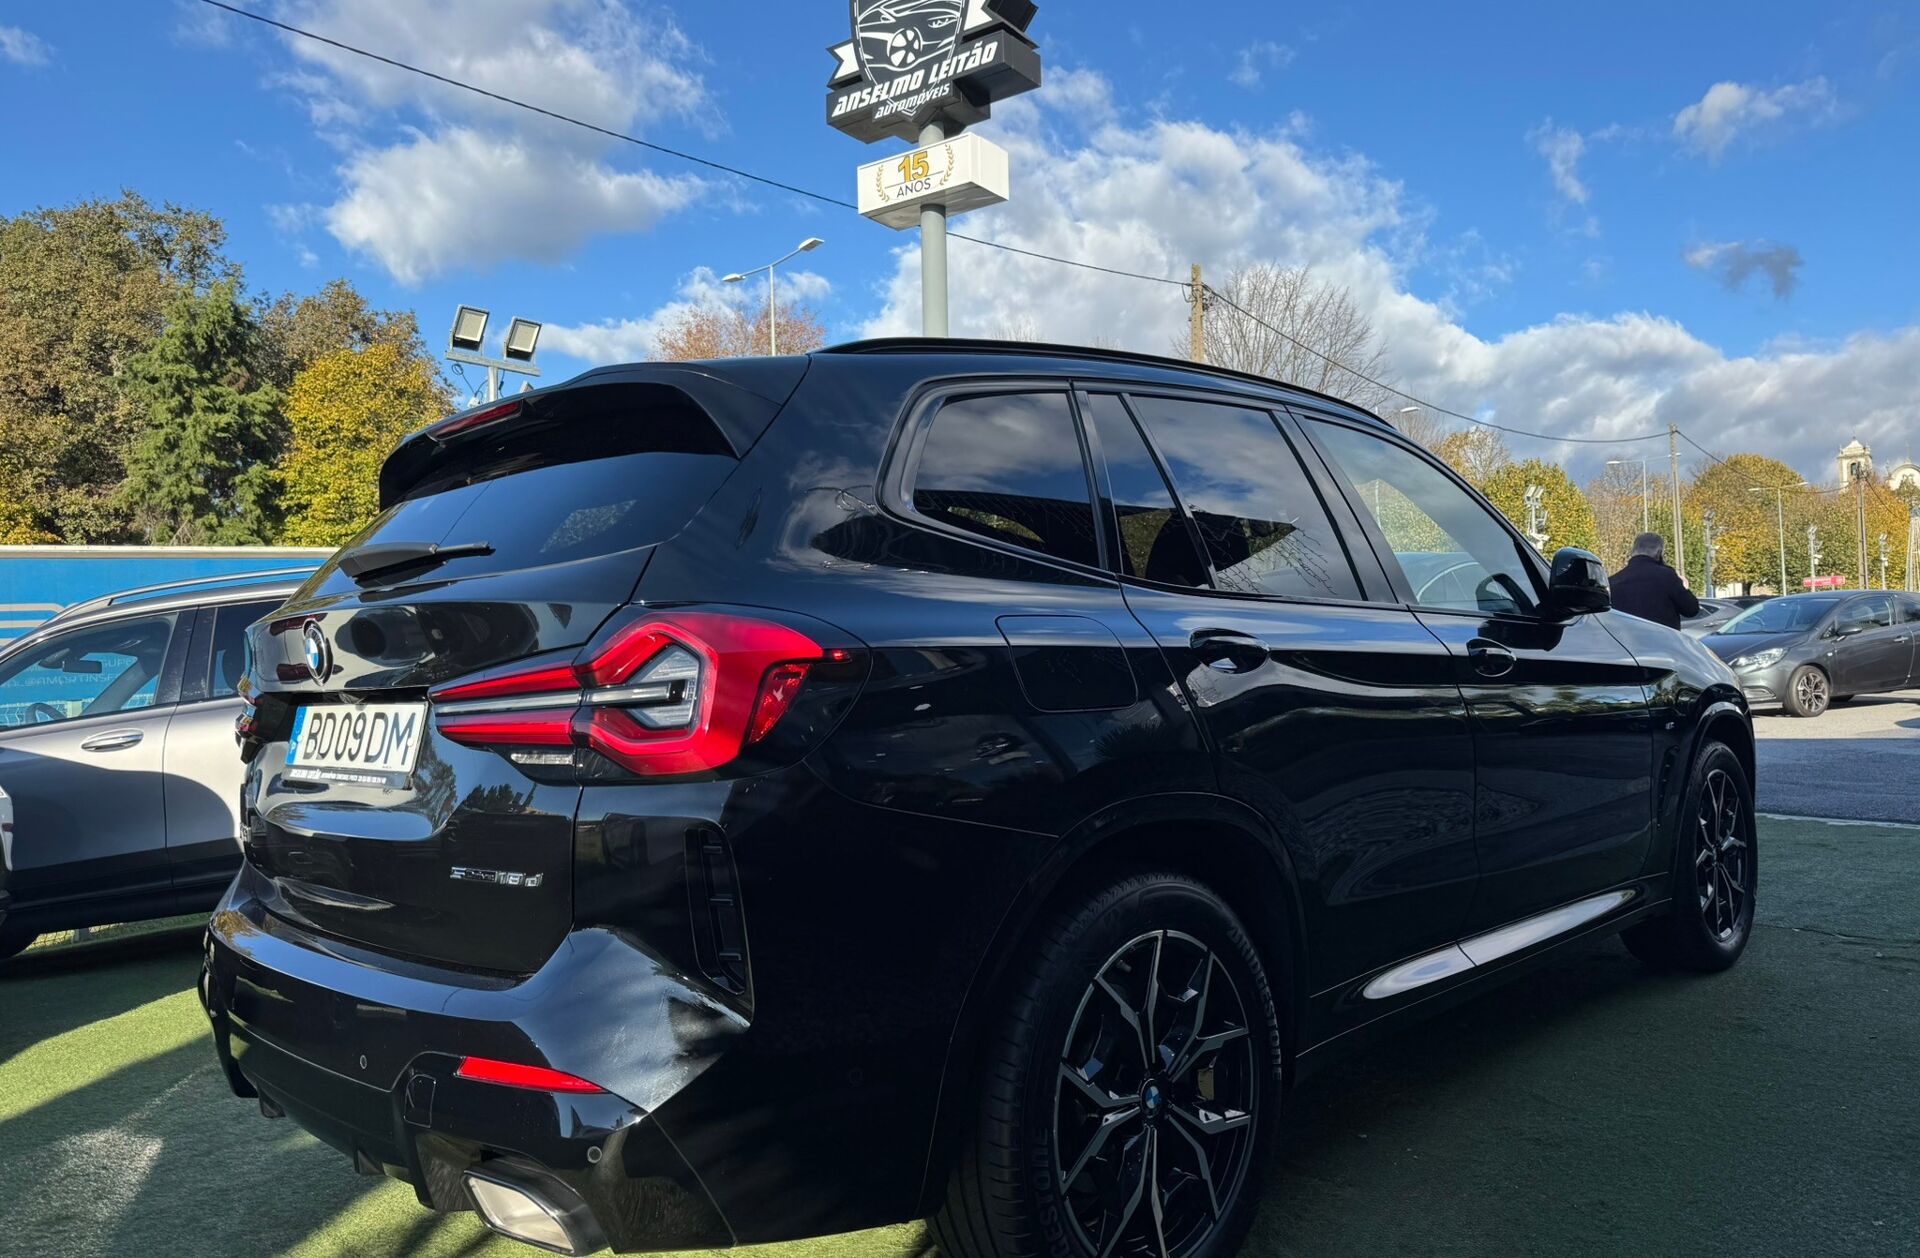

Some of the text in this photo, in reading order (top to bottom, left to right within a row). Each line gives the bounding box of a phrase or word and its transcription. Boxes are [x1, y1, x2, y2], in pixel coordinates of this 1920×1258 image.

[832, 41, 998, 117] ANSELMO LEITÃO
[898, 150, 929, 183] 15
[897, 178, 931, 198] ANOS
